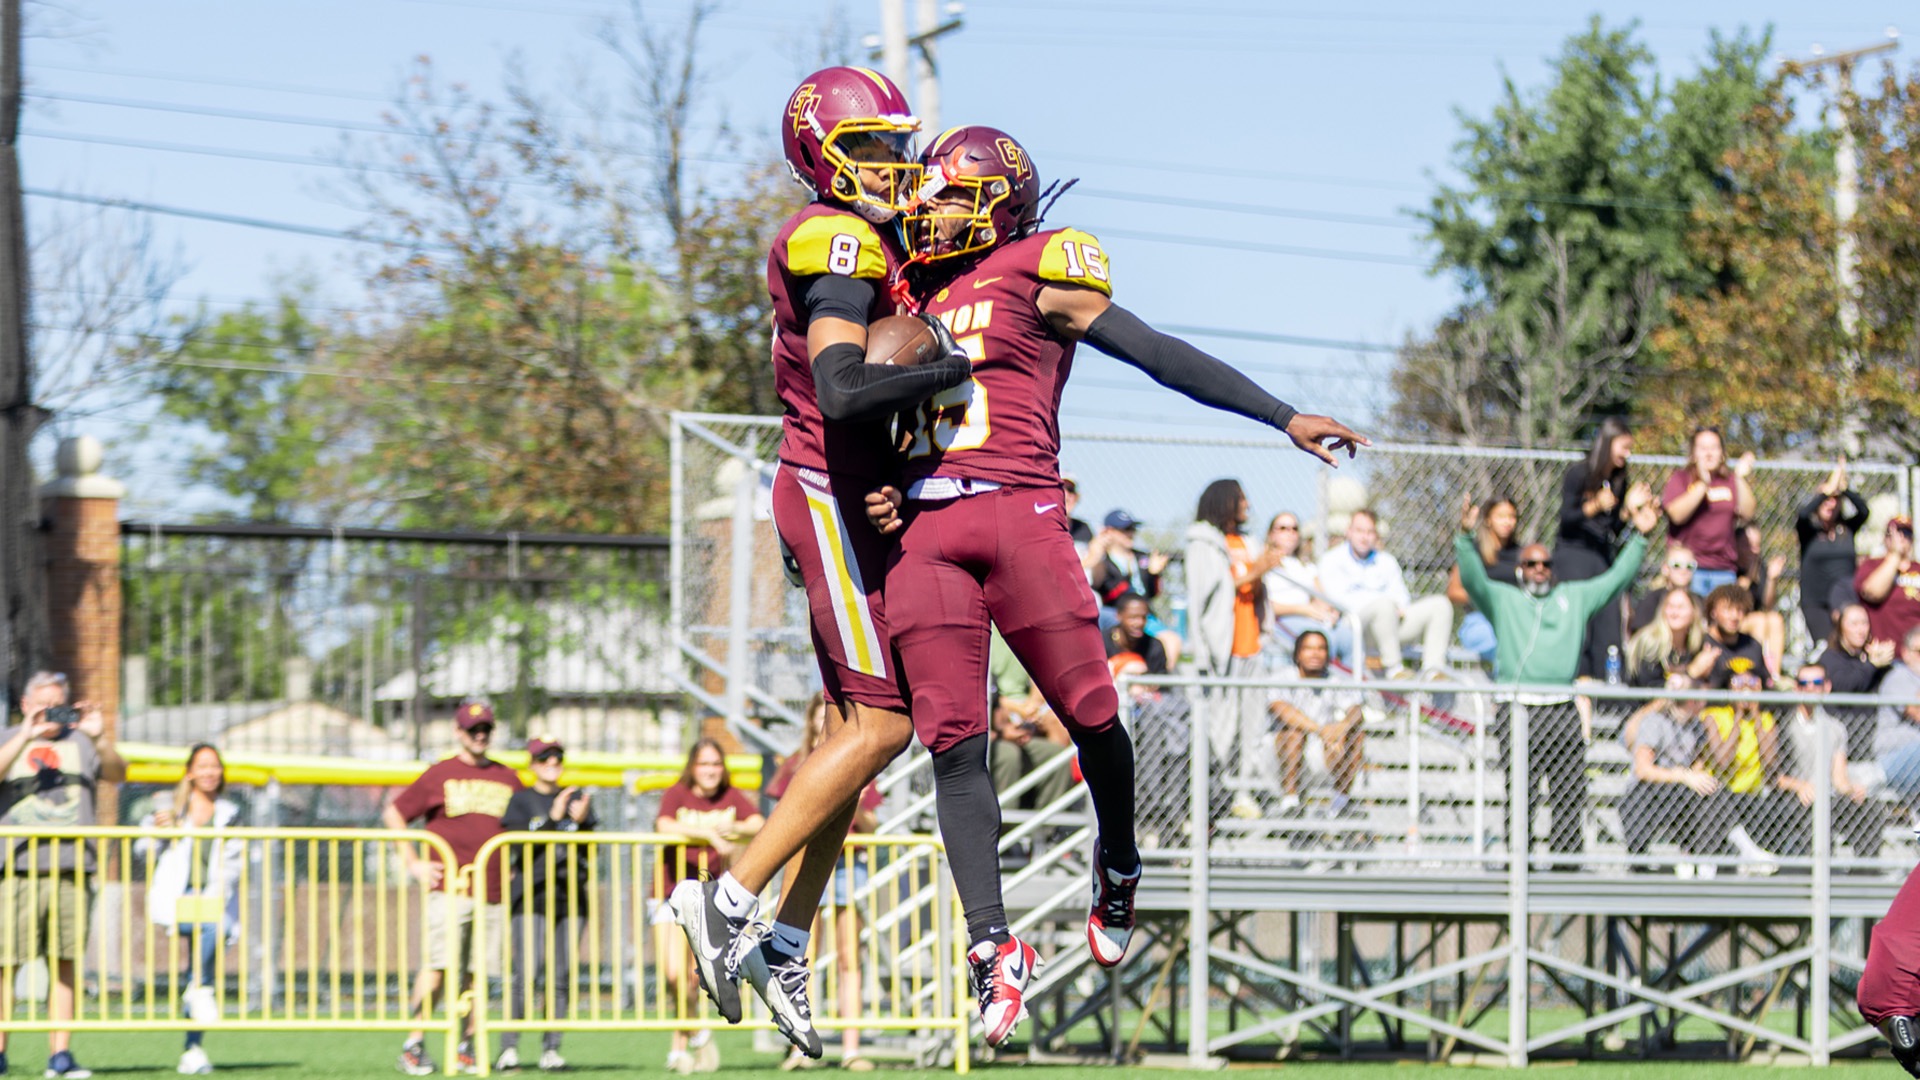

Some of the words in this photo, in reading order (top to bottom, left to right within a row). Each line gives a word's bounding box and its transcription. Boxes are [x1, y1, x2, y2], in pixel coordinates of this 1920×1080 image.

[827, 232, 861, 277] 8
[1061, 240, 1108, 283] 15
[936, 300, 994, 335] NON
